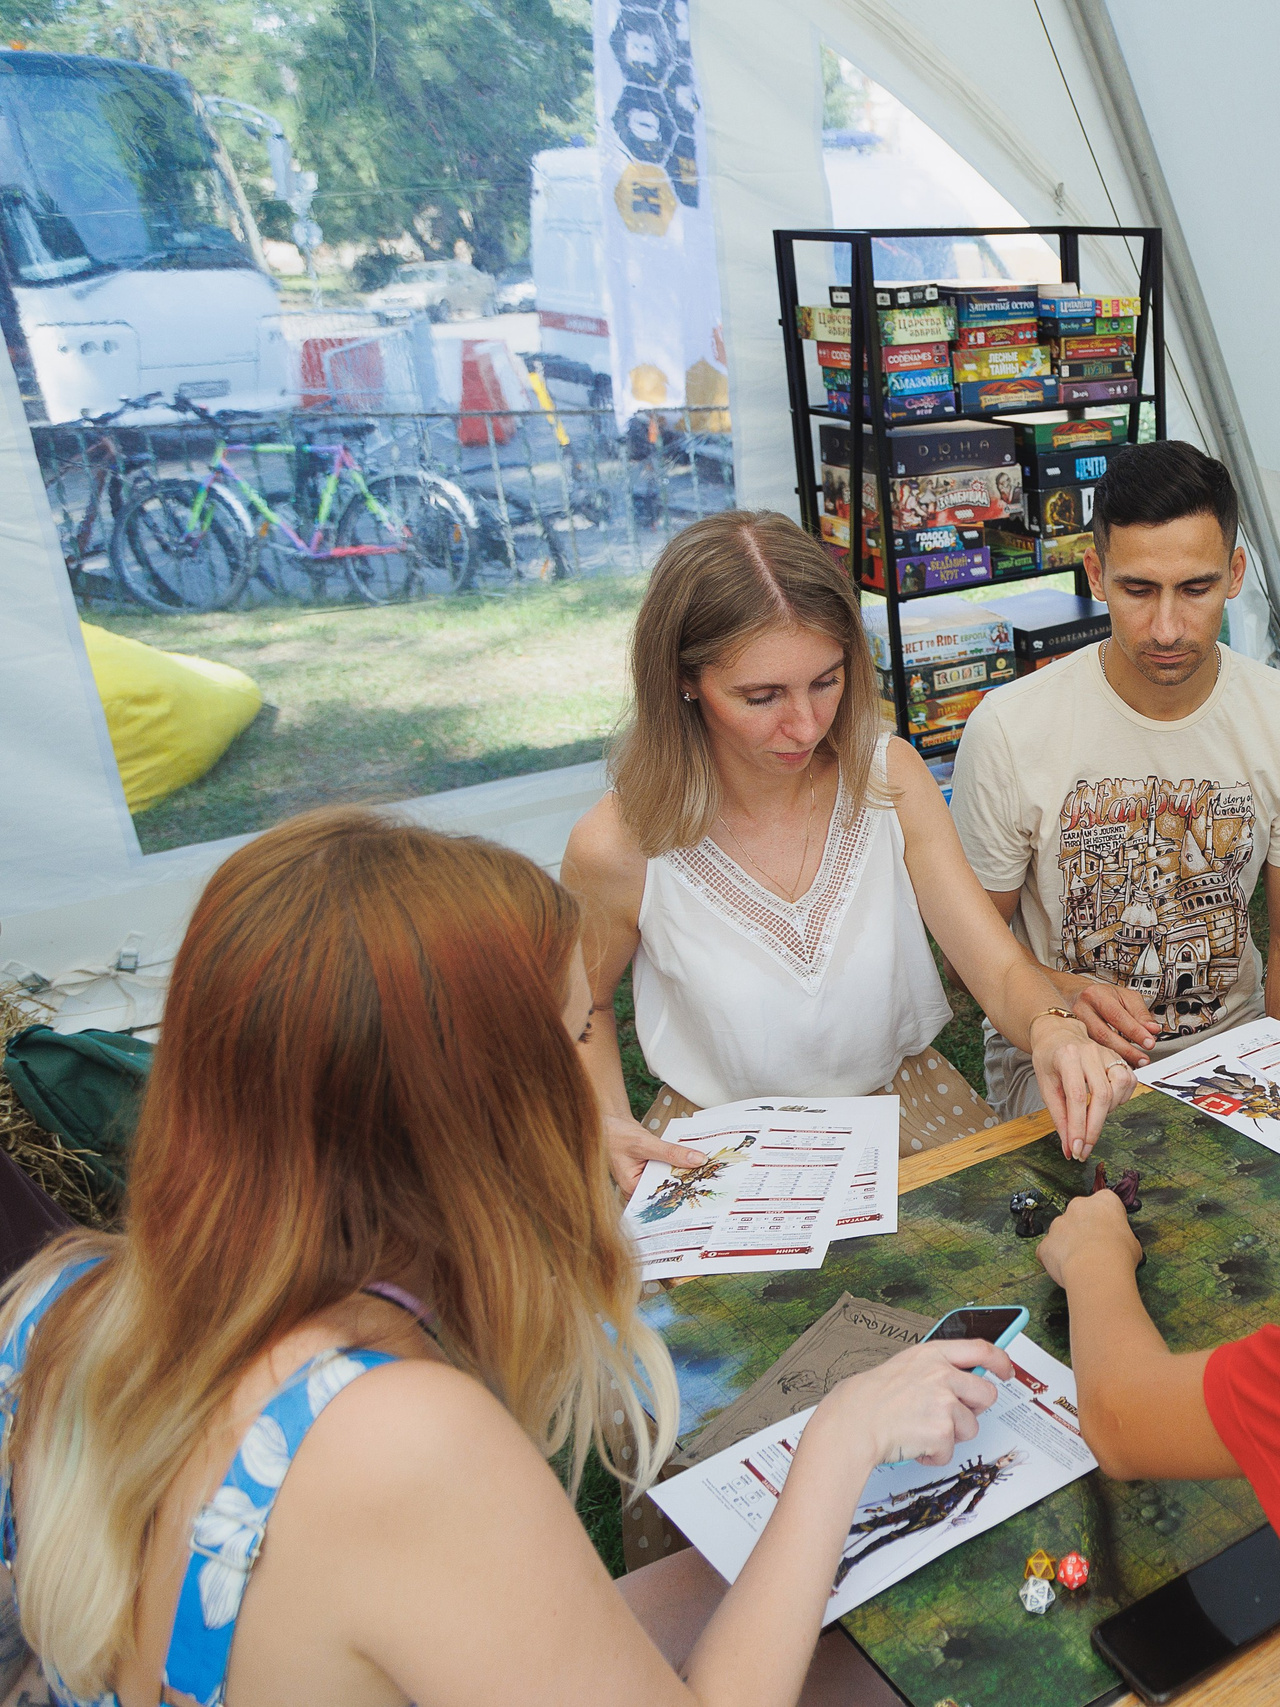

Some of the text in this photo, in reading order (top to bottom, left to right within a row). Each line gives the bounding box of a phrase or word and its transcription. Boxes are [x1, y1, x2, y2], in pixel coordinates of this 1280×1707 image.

[969, 300, 1035, 313] ЗАПРЕТНЫЙ ОСТРОВ
[887, 352, 932, 364] CODENAMES
[988, 351, 1018, 363] ЛЕСНЫЕ
[989, 362, 1020, 375] ТАЙНЫ
[892, 373, 949, 390] АМАЗОНИЯ
[1075, 456, 1107, 479] НЕЧТО
[915, 530, 950, 542] ГОЛОСА
[936, 635, 959, 647] RIDE
[960, 632, 987, 642] ЕВРОПА
[936, 664, 984, 685] ROOT
[1099, 825, 1127, 836] JOURNEY
[1092, 833, 1126, 845] HISTORICAL
[1086, 841, 1112, 852] TIMES
[880, 1323, 926, 1344] WAN
